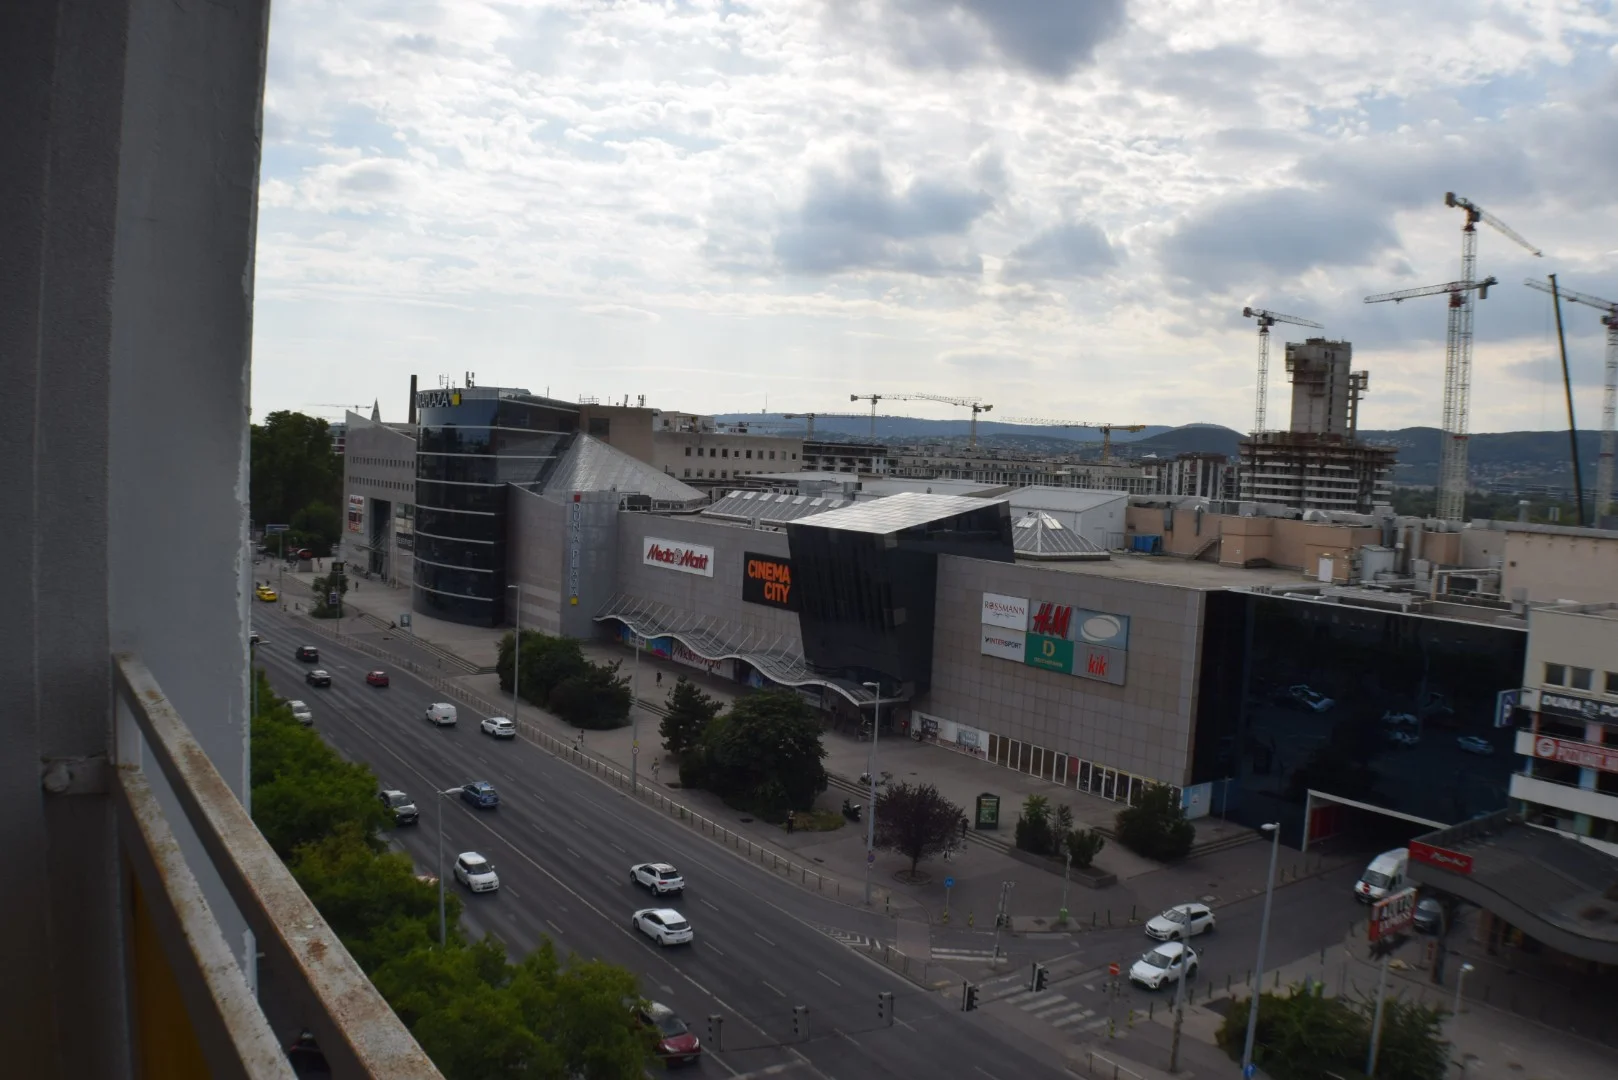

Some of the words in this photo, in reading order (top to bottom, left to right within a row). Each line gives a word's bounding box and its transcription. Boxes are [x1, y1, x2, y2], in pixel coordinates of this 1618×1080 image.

[572, 503, 581, 544] DUNA
[571, 549, 580, 597] PLAZA
[748, 559, 792, 584] CINEMA
[764, 581, 791, 604] CITY
[984, 600, 1025, 616] ROSSMANN
[1032, 601, 1073, 640] H&M
[989, 636, 1022, 650] INTERSPORT
[1042, 640, 1056, 657] D
[1541, 694, 1582, 711] DUNA
